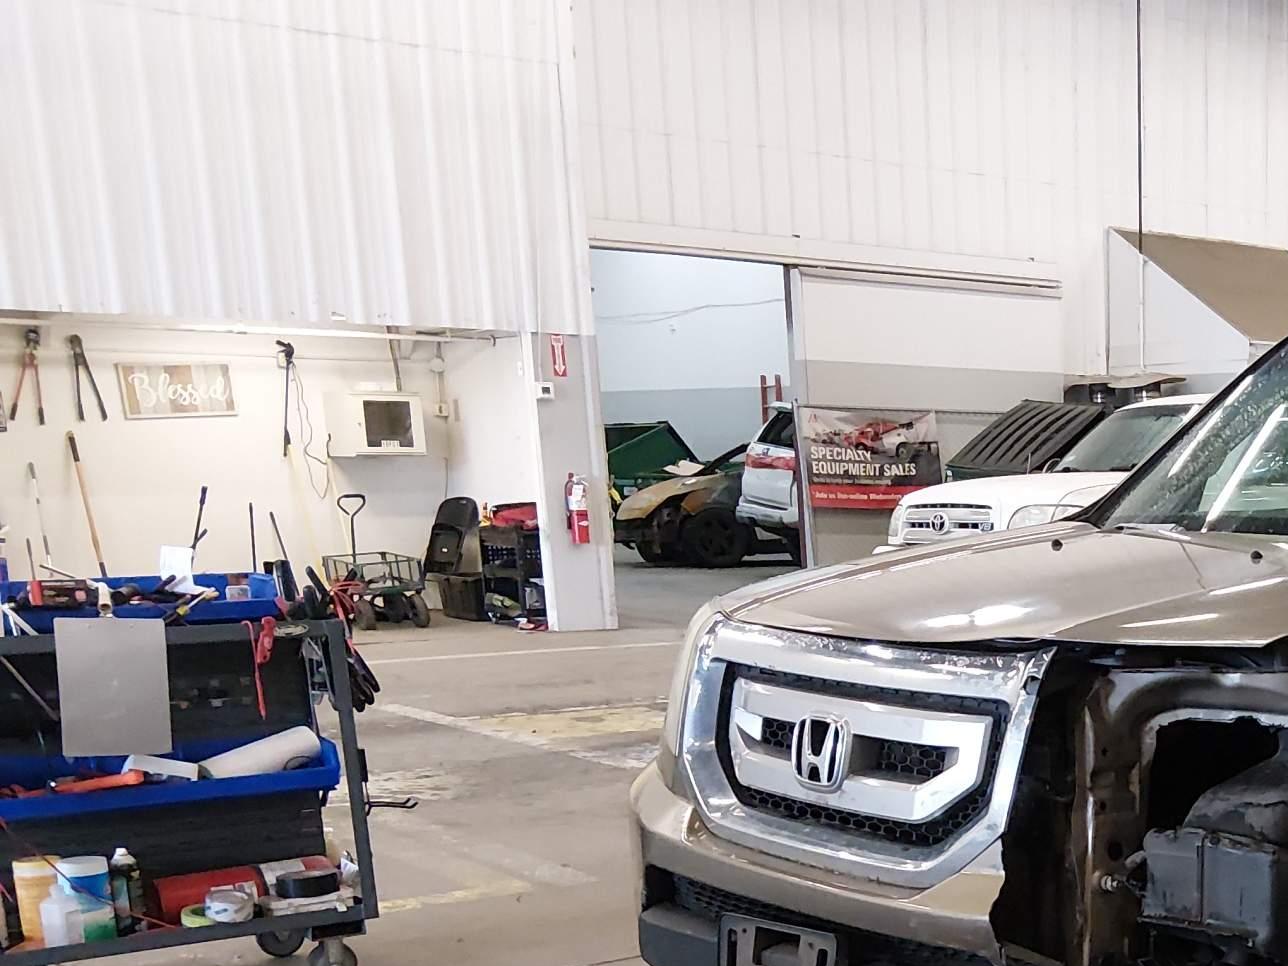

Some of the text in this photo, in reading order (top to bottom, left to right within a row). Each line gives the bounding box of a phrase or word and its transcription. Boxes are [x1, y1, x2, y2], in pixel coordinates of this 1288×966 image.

[128, 371, 230, 407] Blessed
[810, 445, 872, 462] SPECIALTY
[812, 461, 917, 477] EQUIPMENT SALES
